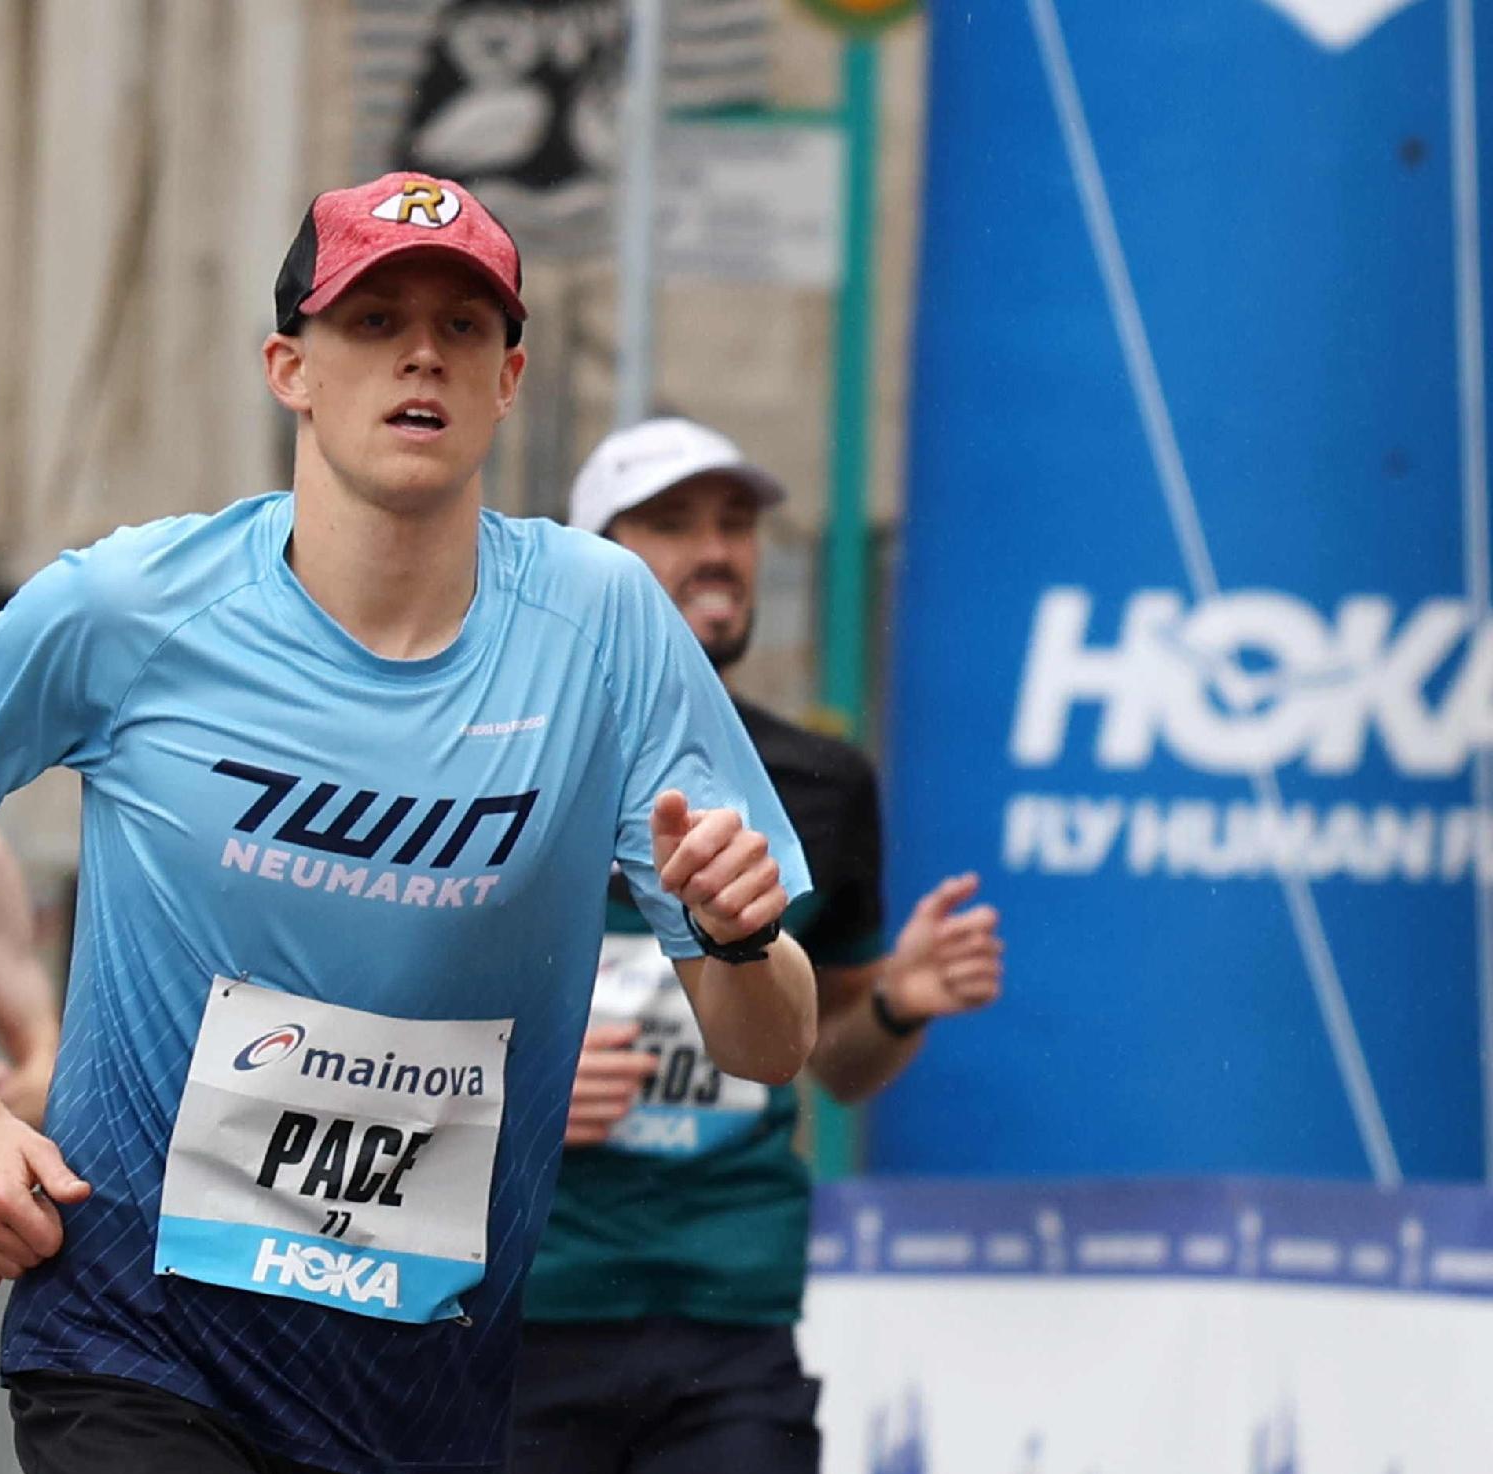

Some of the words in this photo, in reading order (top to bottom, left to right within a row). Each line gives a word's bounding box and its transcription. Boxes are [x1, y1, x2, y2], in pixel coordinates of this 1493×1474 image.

[397, 180, 443, 226] R
[220, 838, 501, 908] NEUMARKT
[300, 1047, 483, 1096] mainova
[610, 1111, 698, 1149] OKA
[256, 1110, 433, 1207] PACE
[319, 1210, 352, 1239] 77
[251, 1238, 399, 1310] HOKA
